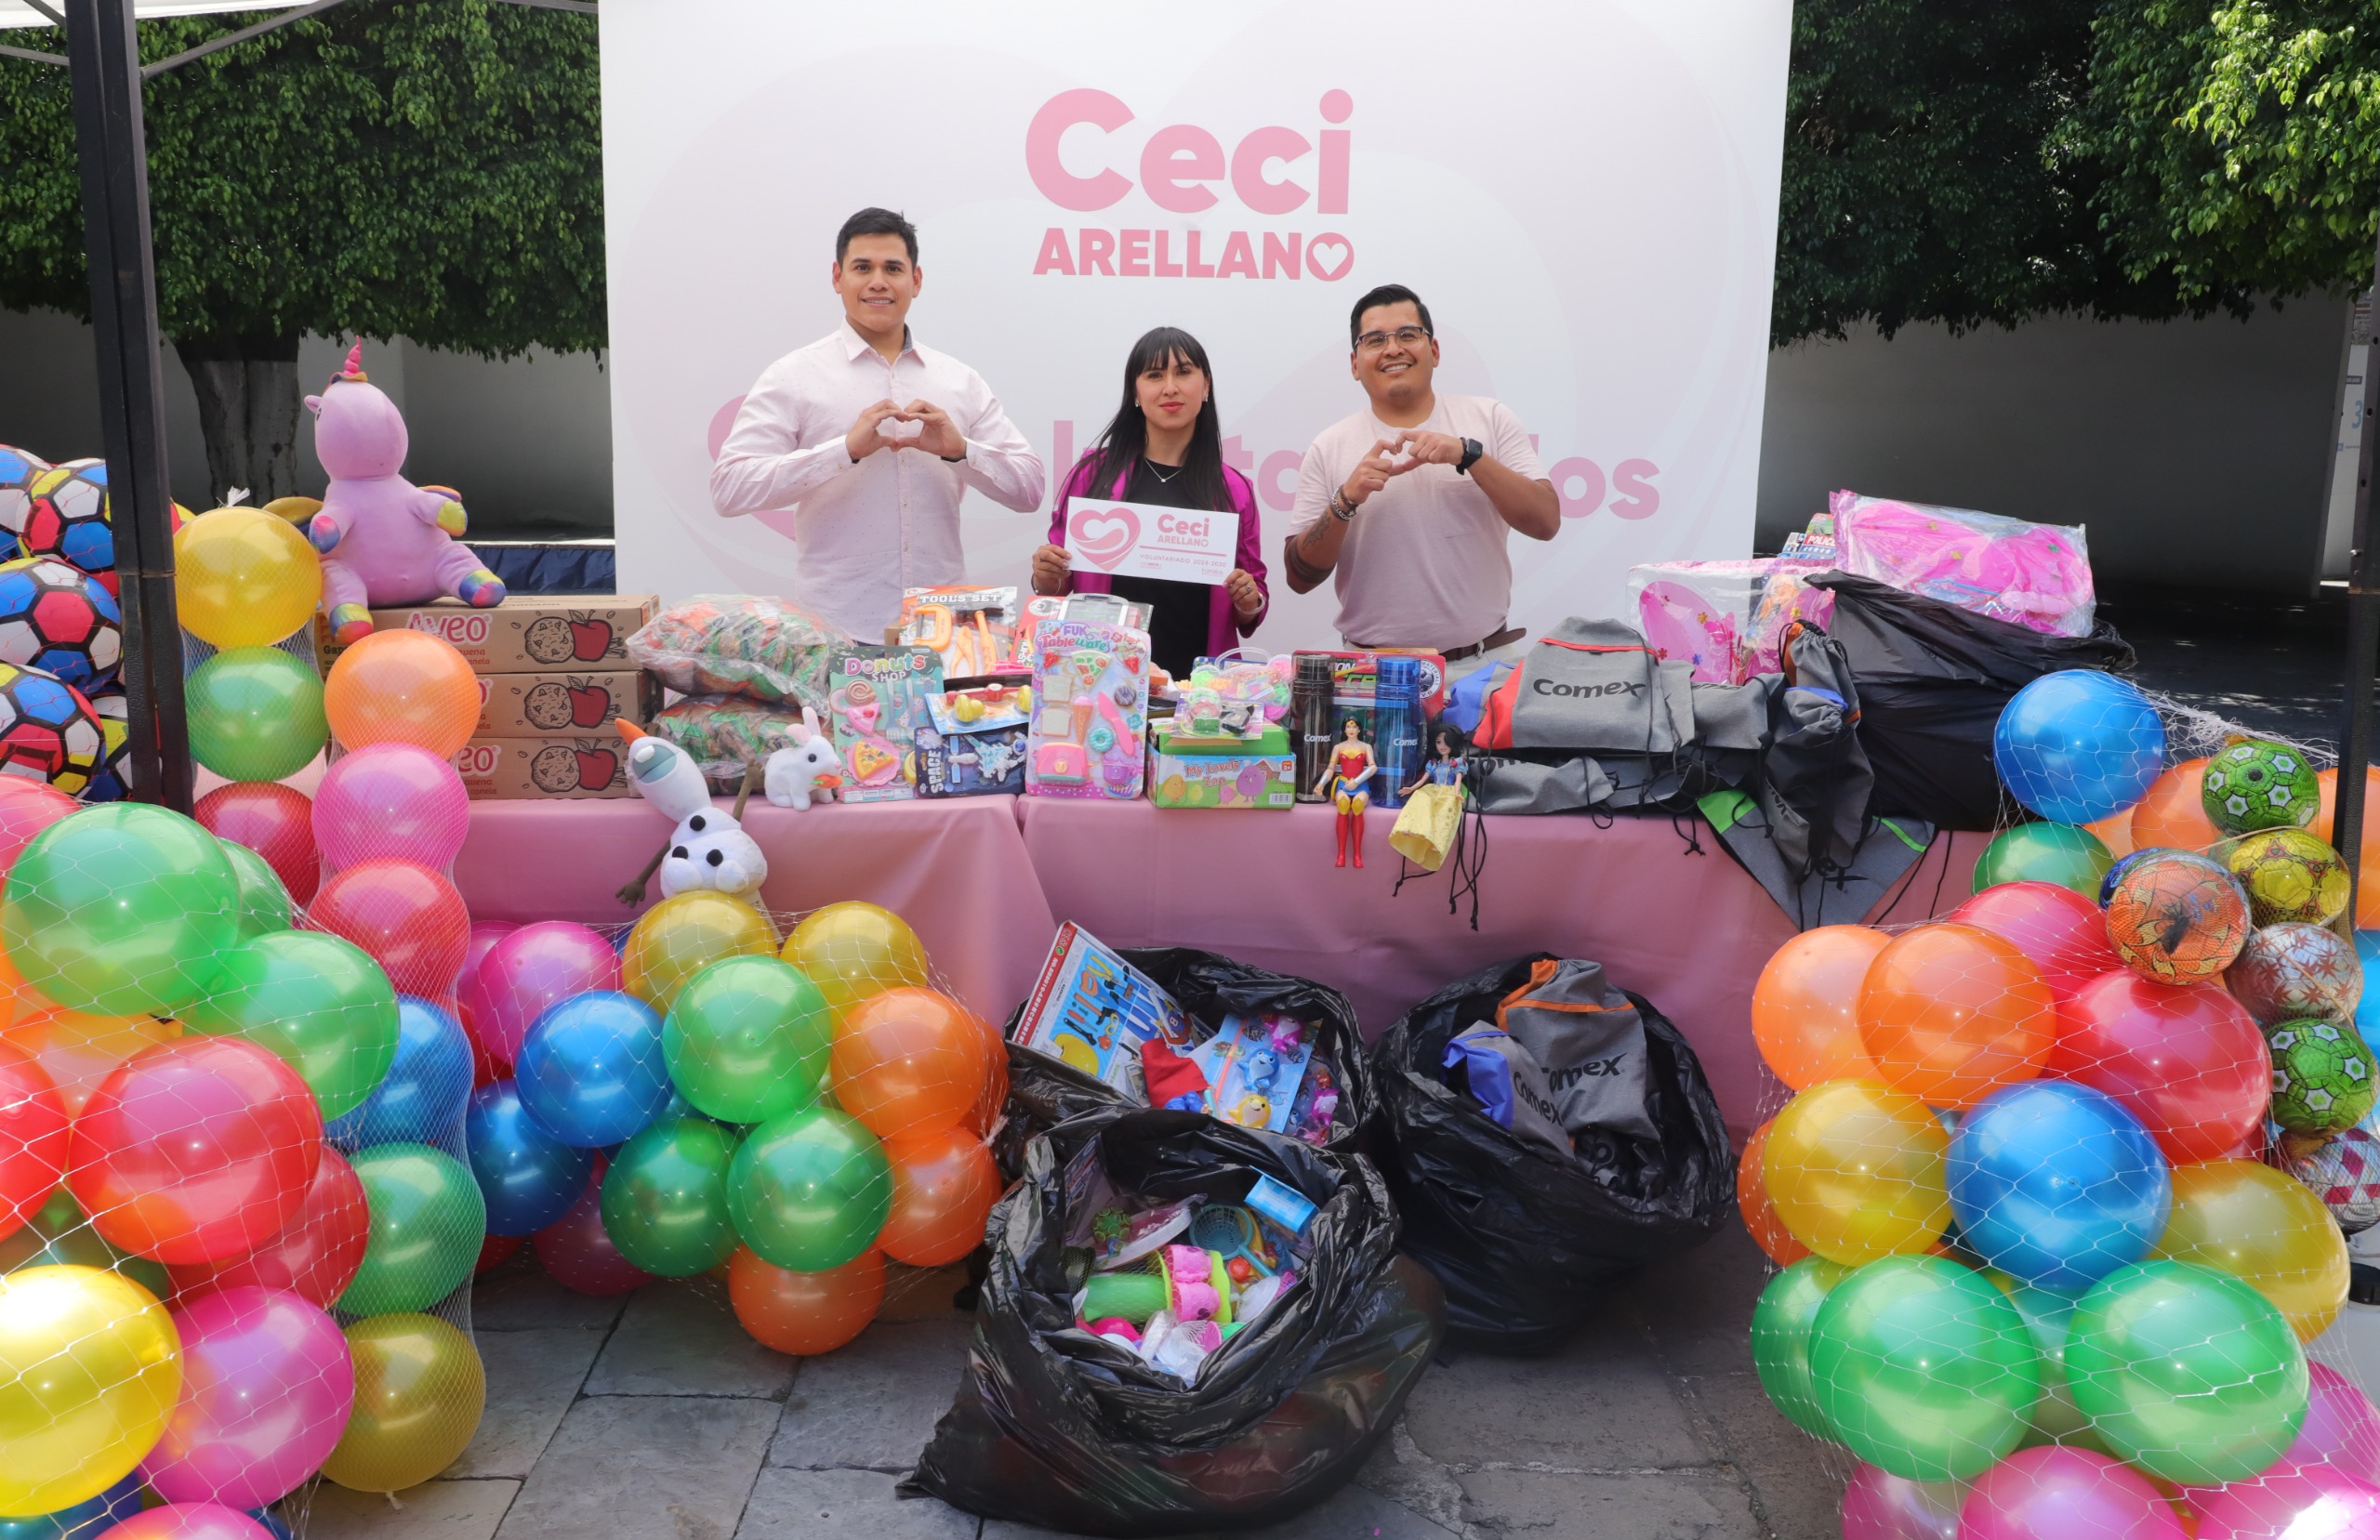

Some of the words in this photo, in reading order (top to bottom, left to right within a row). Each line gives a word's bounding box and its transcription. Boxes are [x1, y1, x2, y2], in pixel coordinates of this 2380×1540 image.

[1025, 88, 1354, 215] Ceci
[1032, 228, 1355, 282] ARELLANO
[1157, 514, 1210, 536] Ceci
[1157, 534, 1210, 547] ARELLANO
[1140, 553, 1191, 564] VOLUNTARIADO
[919, 595, 967, 603] TOOLS
[971, 594, 1001, 602] SET
[1041, 633, 1108, 652] Tableware
[845, 652, 926, 677] Donuts
[871, 671, 906, 682] SHOP
[1532, 678, 1646, 700] Comex
[1303, 732, 1332, 743] Comex
[928, 749, 945, 794] SPACE
[1184, 763, 1205, 776] My
[1205, 758, 1243, 775] Lovely
[1203, 776, 1226, 787] Zoo
[1540, 1052, 1628, 1094] omex
[1514, 1071, 1564, 1126] Comex
